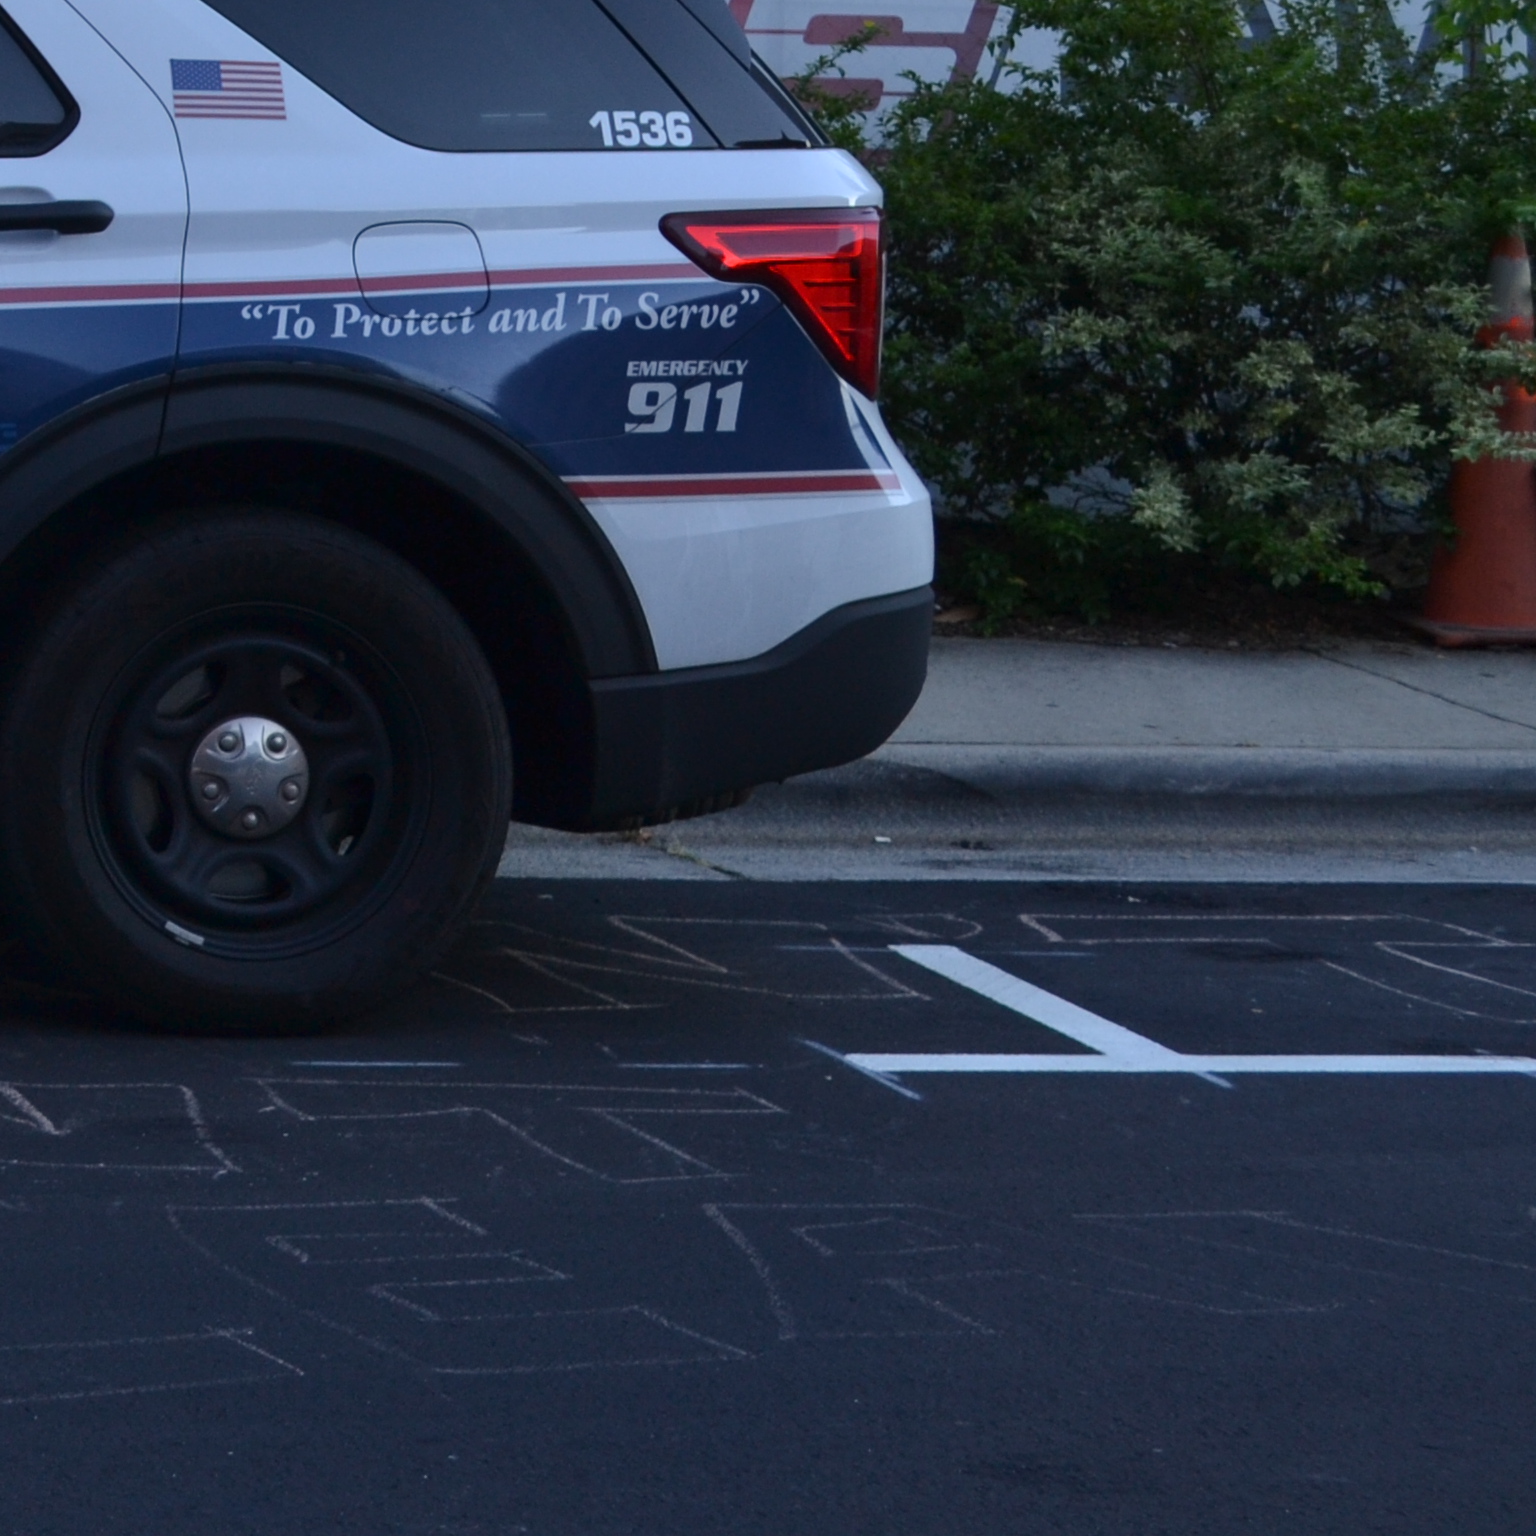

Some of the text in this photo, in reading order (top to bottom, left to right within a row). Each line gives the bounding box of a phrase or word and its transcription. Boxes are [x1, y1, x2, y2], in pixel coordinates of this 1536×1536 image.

[588, 109, 694, 148] 1536
[330, 300, 476, 340] Protect
[488, 292, 567, 334] and
[576, 292, 623, 333] To
[625, 359, 749, 378] EMERGENCY
[624, 380, 745, 434] 911
